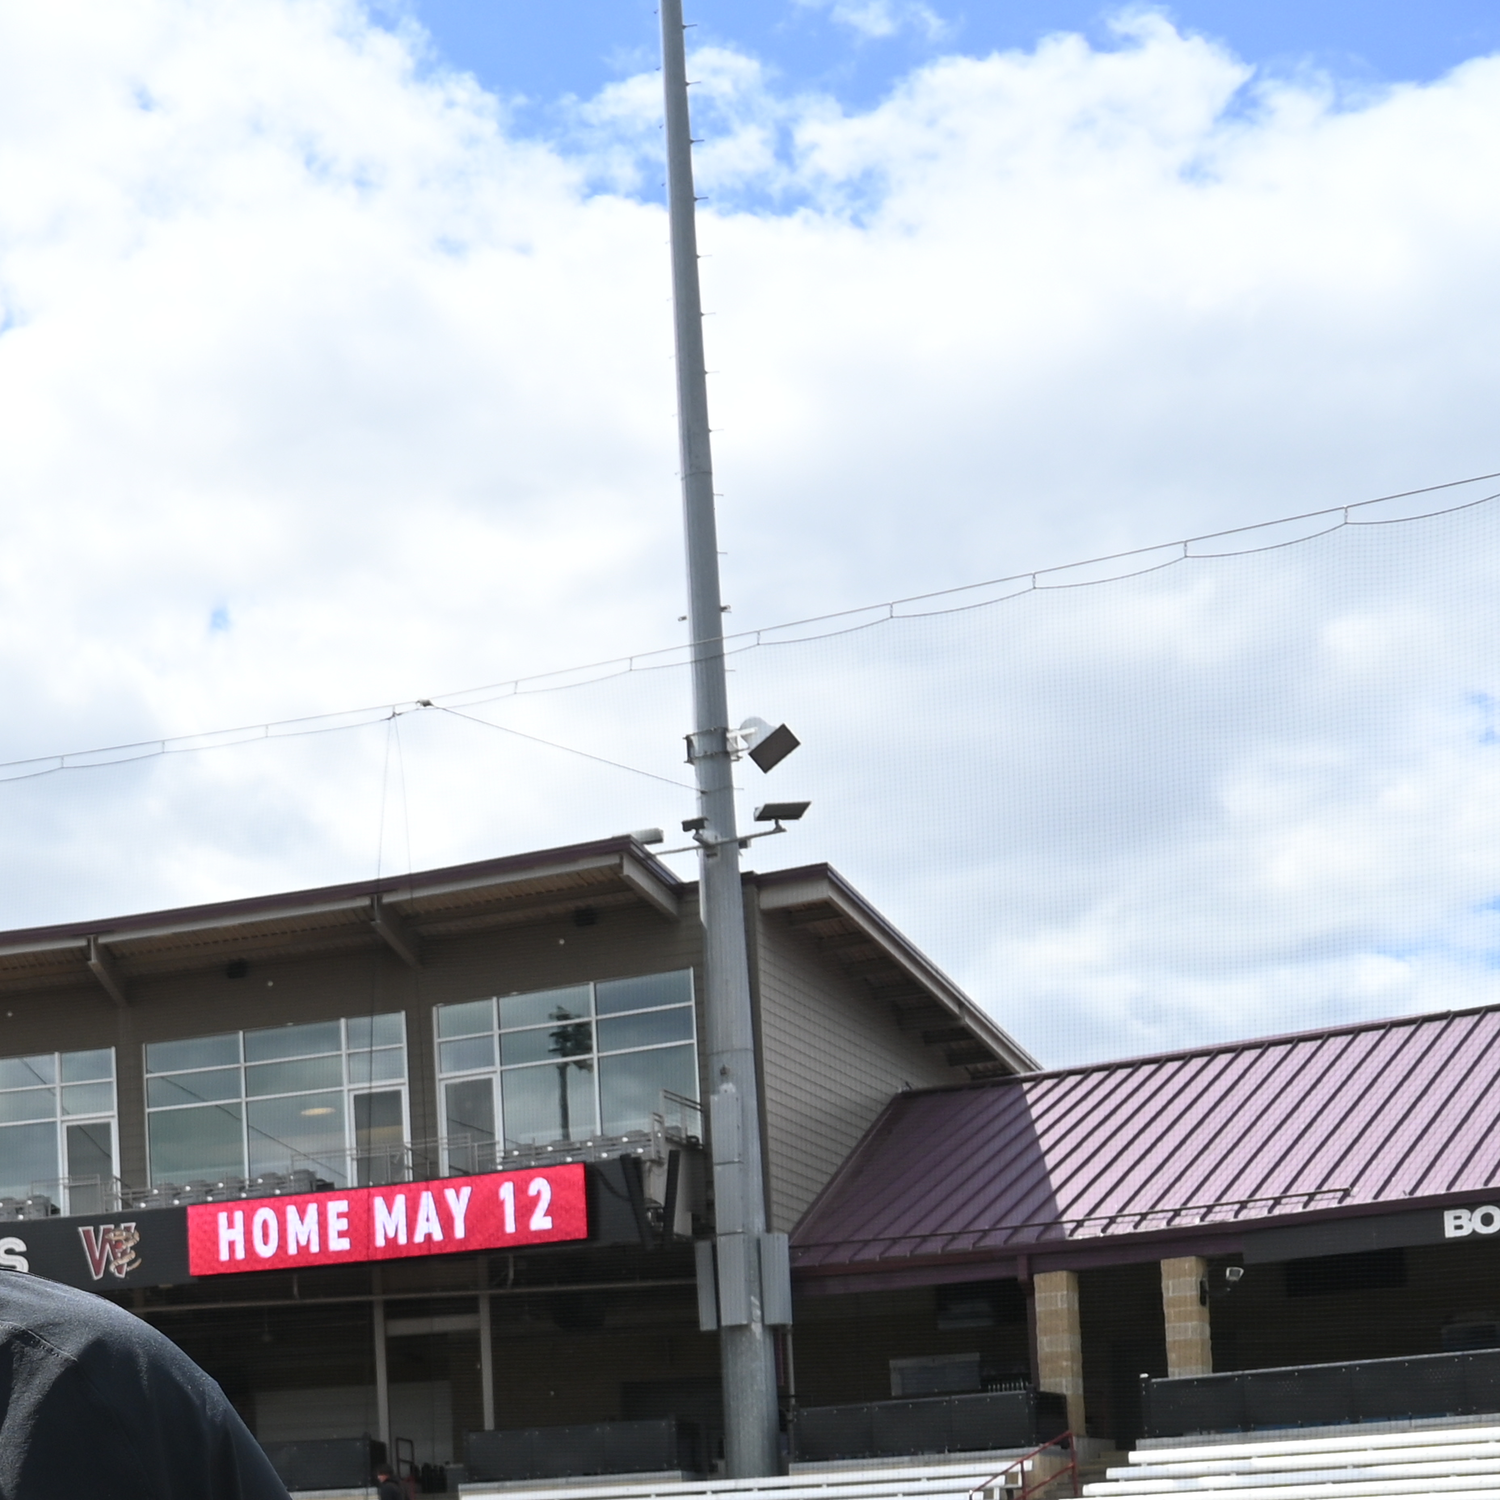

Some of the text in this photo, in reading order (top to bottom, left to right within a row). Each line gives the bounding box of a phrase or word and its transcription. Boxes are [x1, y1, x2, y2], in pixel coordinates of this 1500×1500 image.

[217, 1177, 553, 1262] HOME MAY 12
